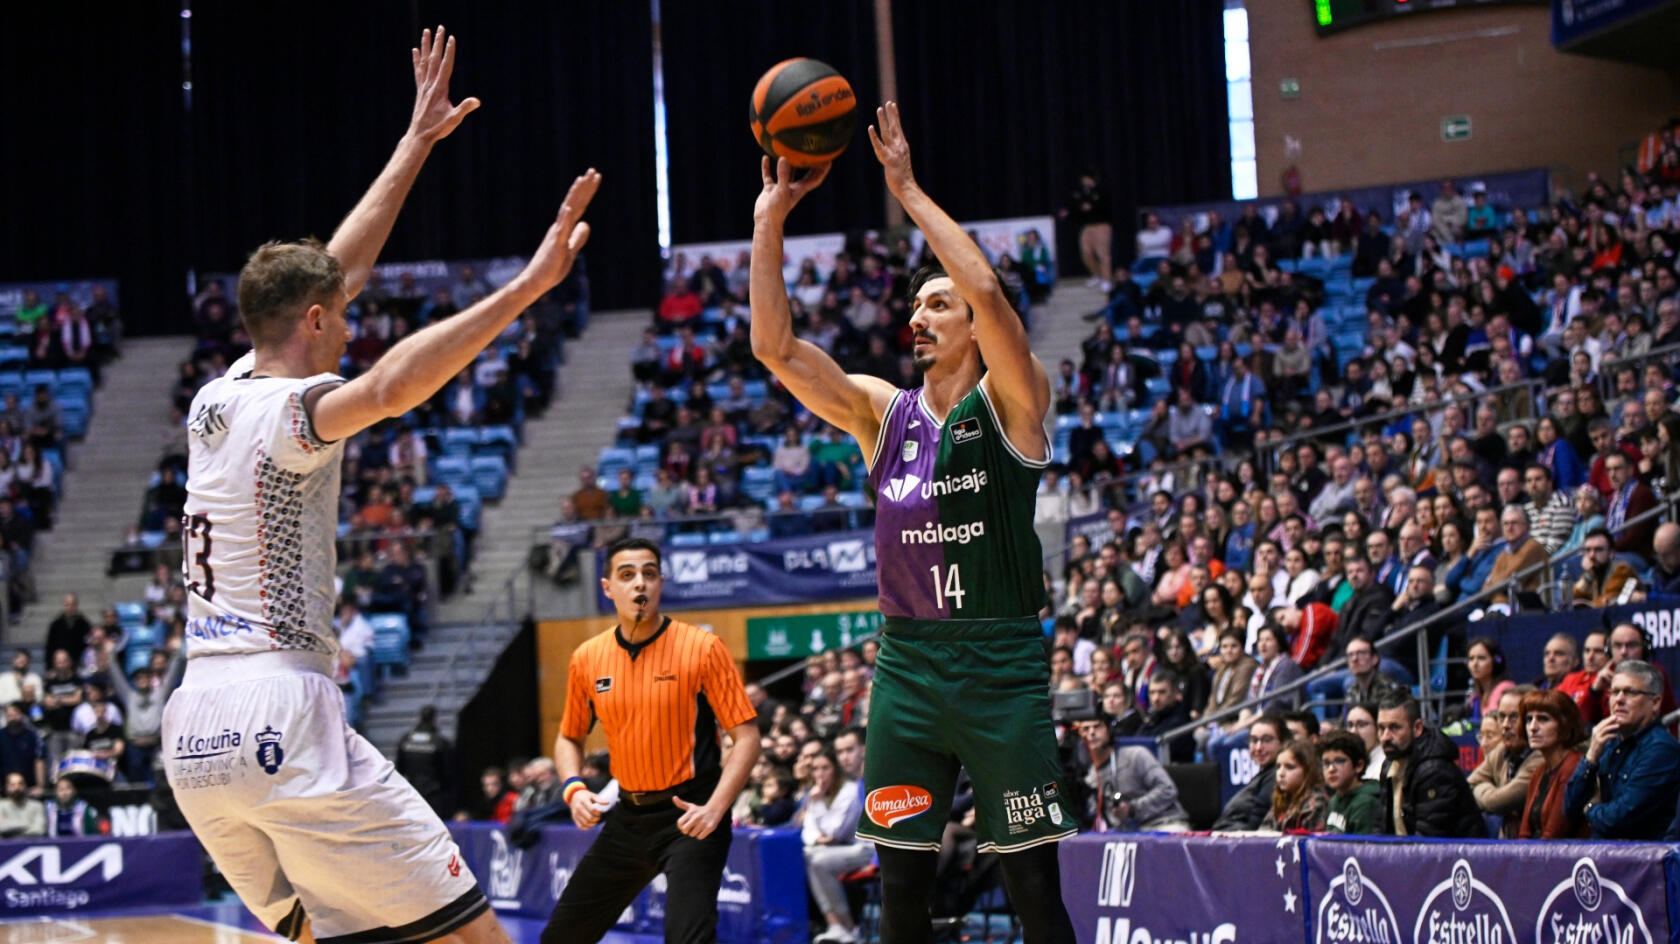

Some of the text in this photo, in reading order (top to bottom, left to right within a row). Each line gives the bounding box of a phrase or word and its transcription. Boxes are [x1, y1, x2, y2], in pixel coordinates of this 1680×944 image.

[920, 468, 988, 500] Unicaja
[930, 563, 966, 609] 14
[187, 728, 242, 753] Coruña
[5, 888, 90, 909] Santiago
